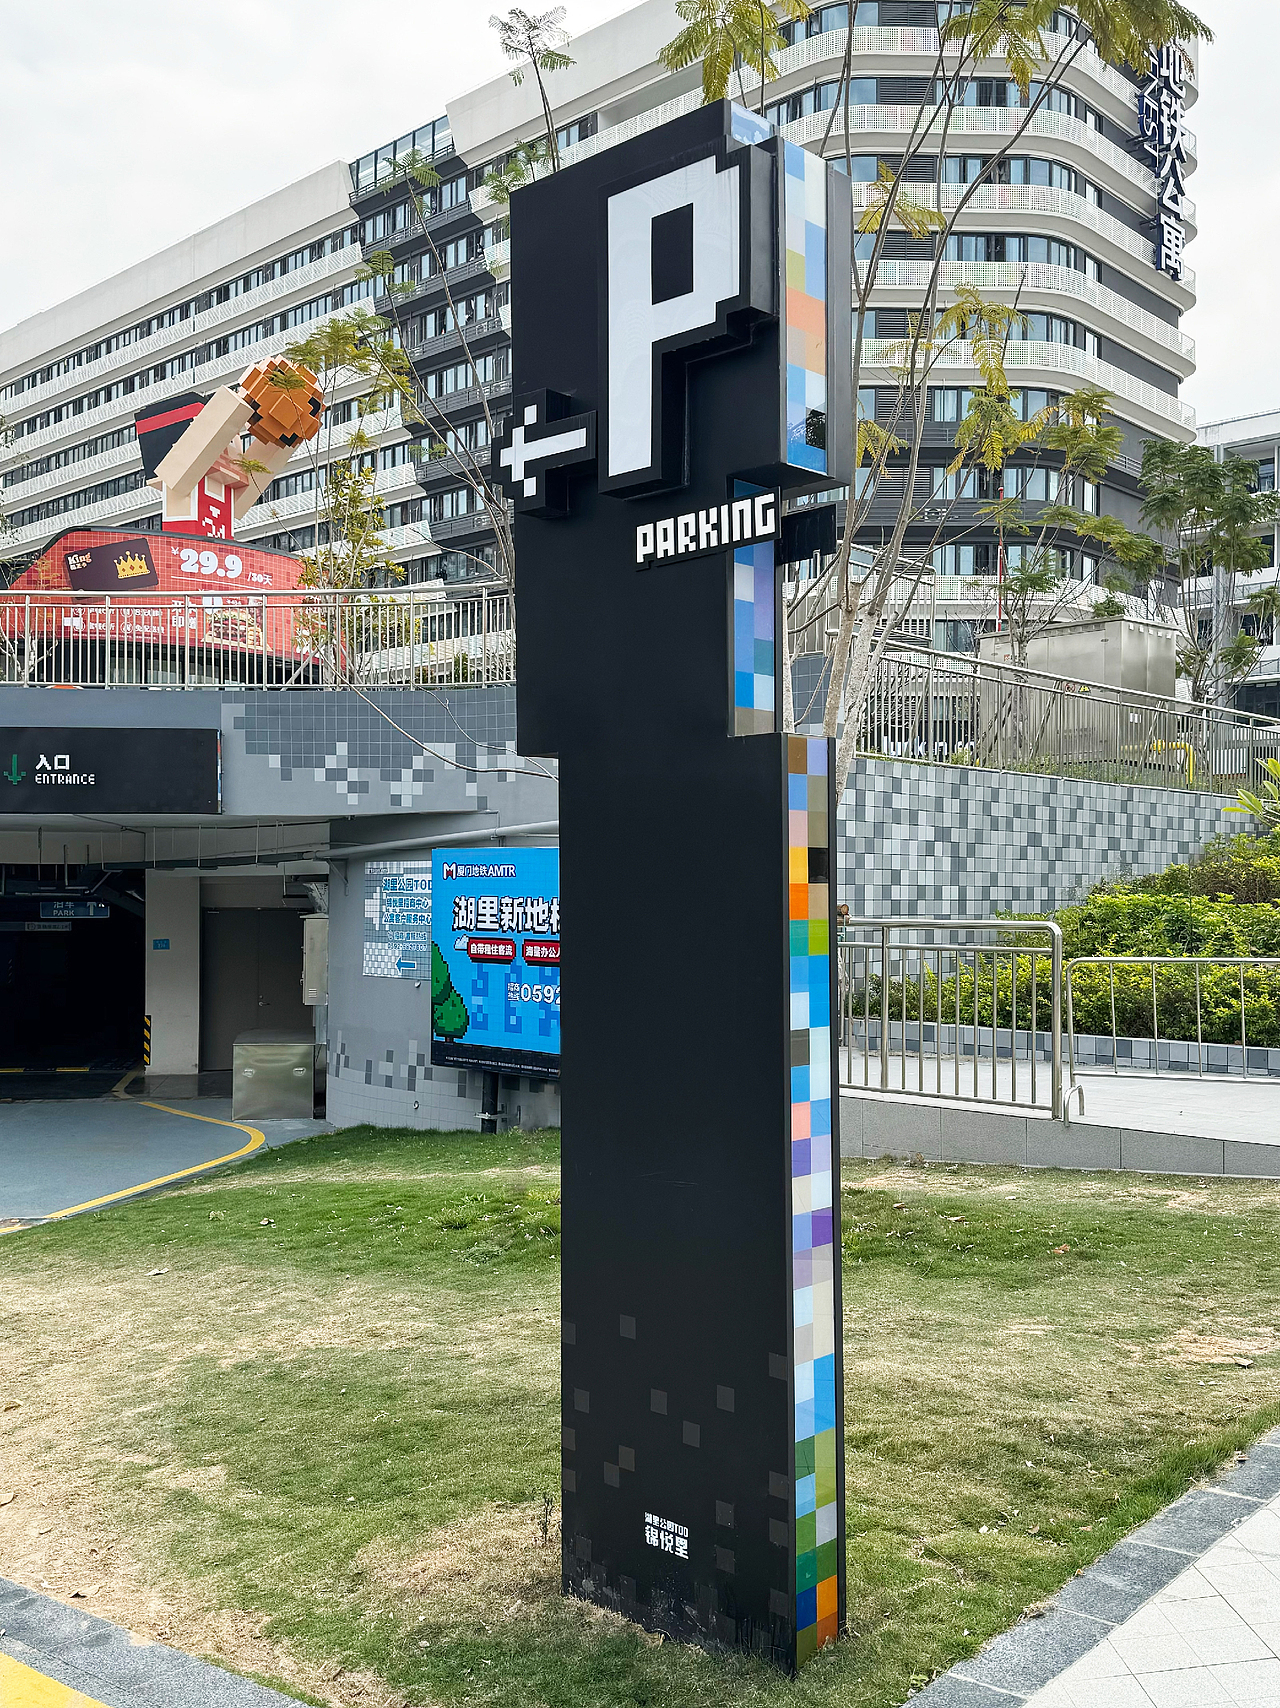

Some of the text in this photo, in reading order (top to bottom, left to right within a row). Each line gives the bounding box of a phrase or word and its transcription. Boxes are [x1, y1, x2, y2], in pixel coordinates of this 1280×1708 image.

[1160, 41, 1187, 281] 地铁公寓
[608, 155, 740, 478] P
[636, 493, 776, 563] PARKING
[67, 552, 92, 565] King
[35, 754, 70, 770] 入口
[35, 773, 95, 785] ENTRANCE
[644, 1524, 689, 1560] 锦悦里
